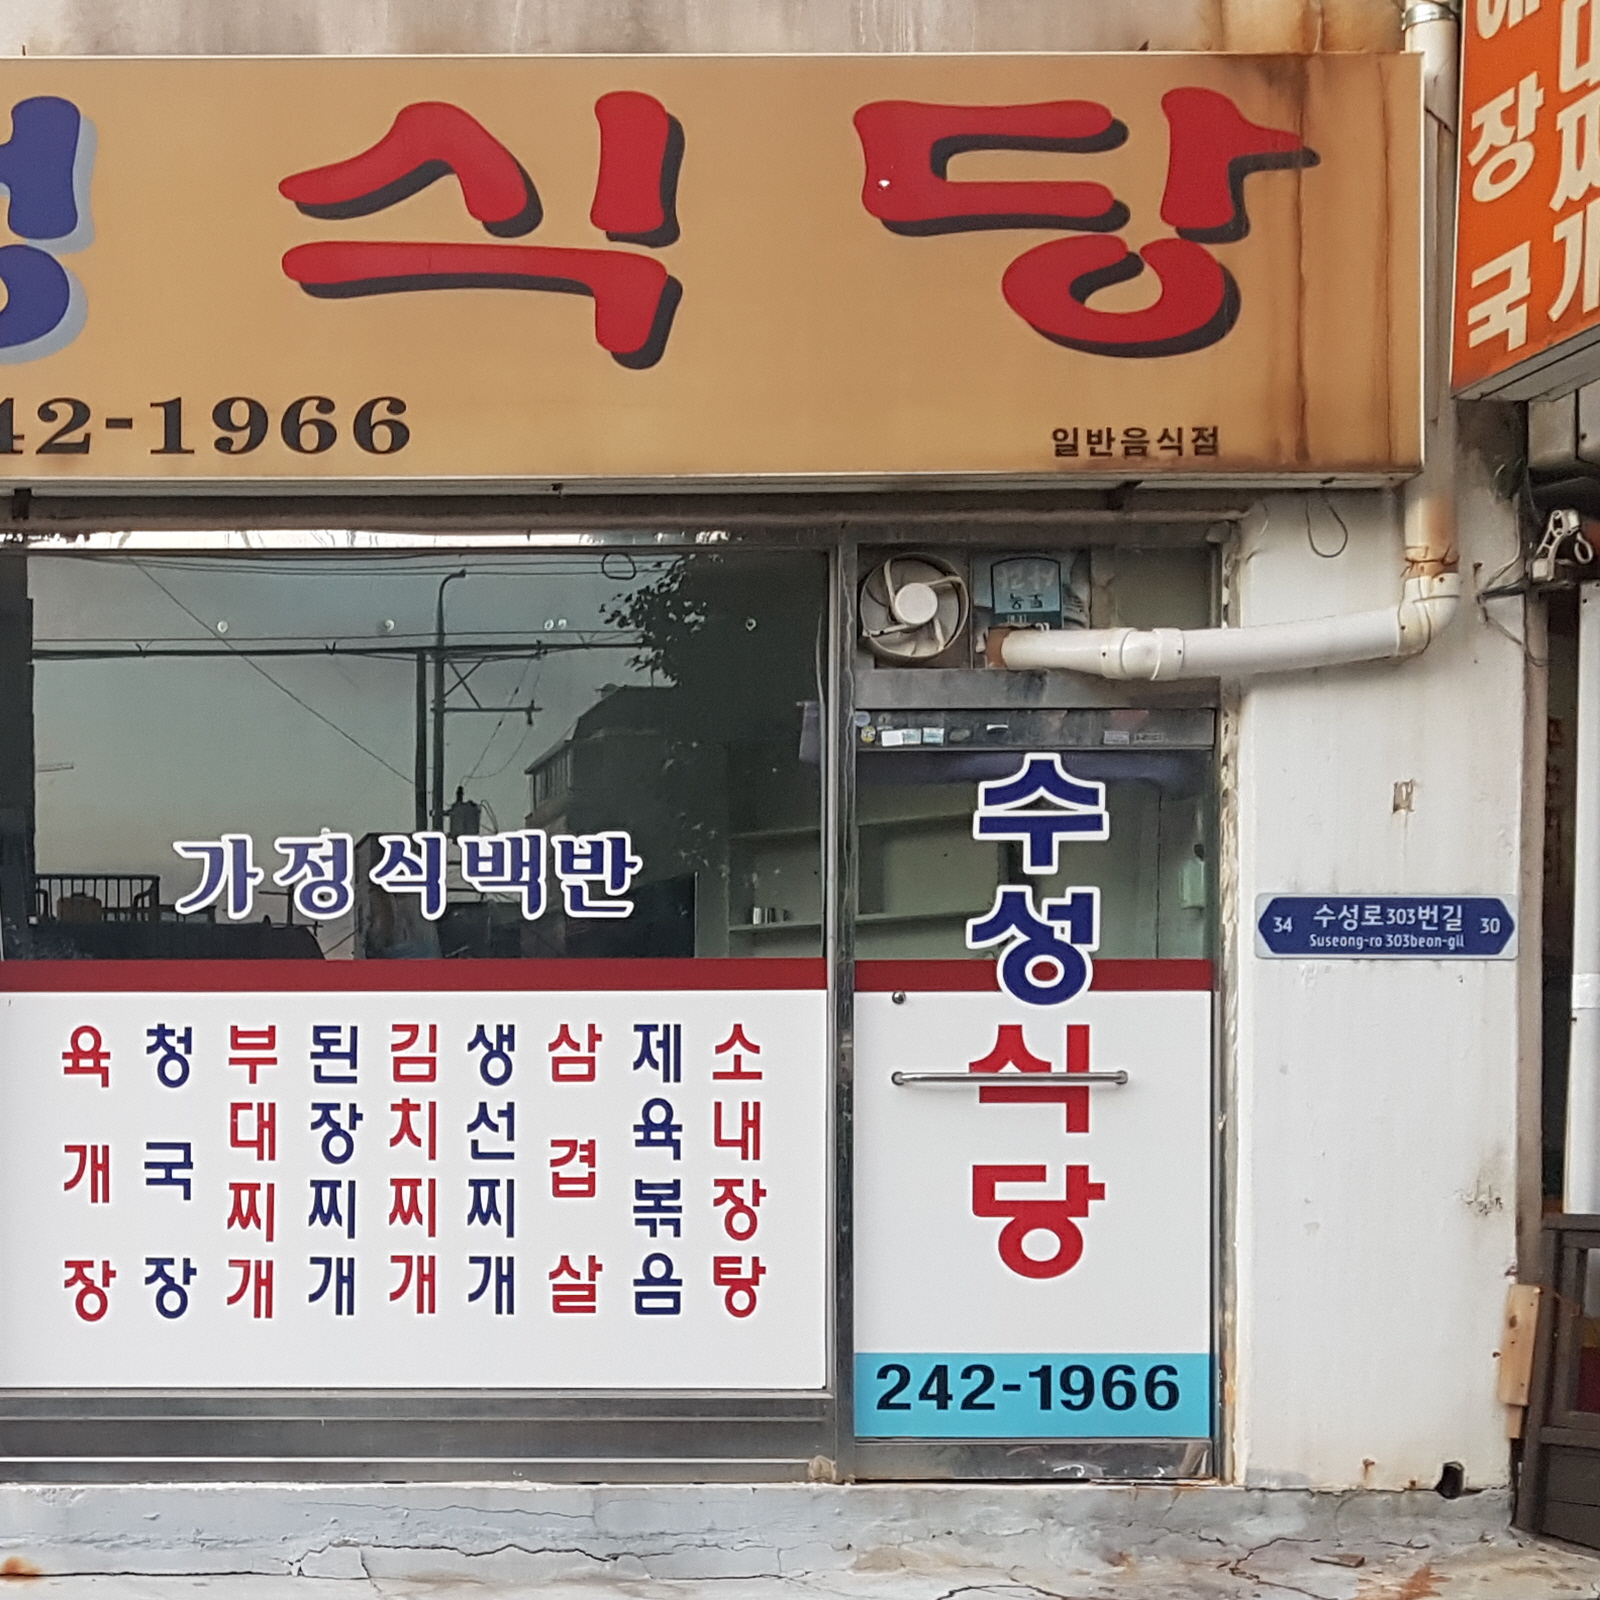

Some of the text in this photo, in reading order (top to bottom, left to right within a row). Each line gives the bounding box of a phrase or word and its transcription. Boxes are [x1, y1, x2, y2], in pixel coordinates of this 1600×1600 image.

[1050, 424, 1221, 458] 일반음식점
[172, 829, 643, 921] 가정식백반
[967, 753, 1110, 1279] 수성식당
[1273, 916, 1293, 933] 34
[1309, 933, 1465, 949] Suseong-ro 303beon-gil
[1312, 903, 1463, 932] 수성로303번길
[1479, 917, 1500, 934] 30
[61, 1024, 116, 1322] 육개장
[144, 1023, 197, 1320] 청국장
[226, 1024, 277, 1319] 부대찌개
[308, 1024, 363, 1316] 된장찌개
[388, 1023, 438, 1314] 김치찌개
[466, 1023, 516, 1316] 생선찌개
[547, 1023, 603, 1314] 삼겹살
[632, 1022, 683, 1316] 제육볶음
[711, 1023, 767, 1318] 소내장탕
[875, 1363, 1182, 1413] 242-1966
